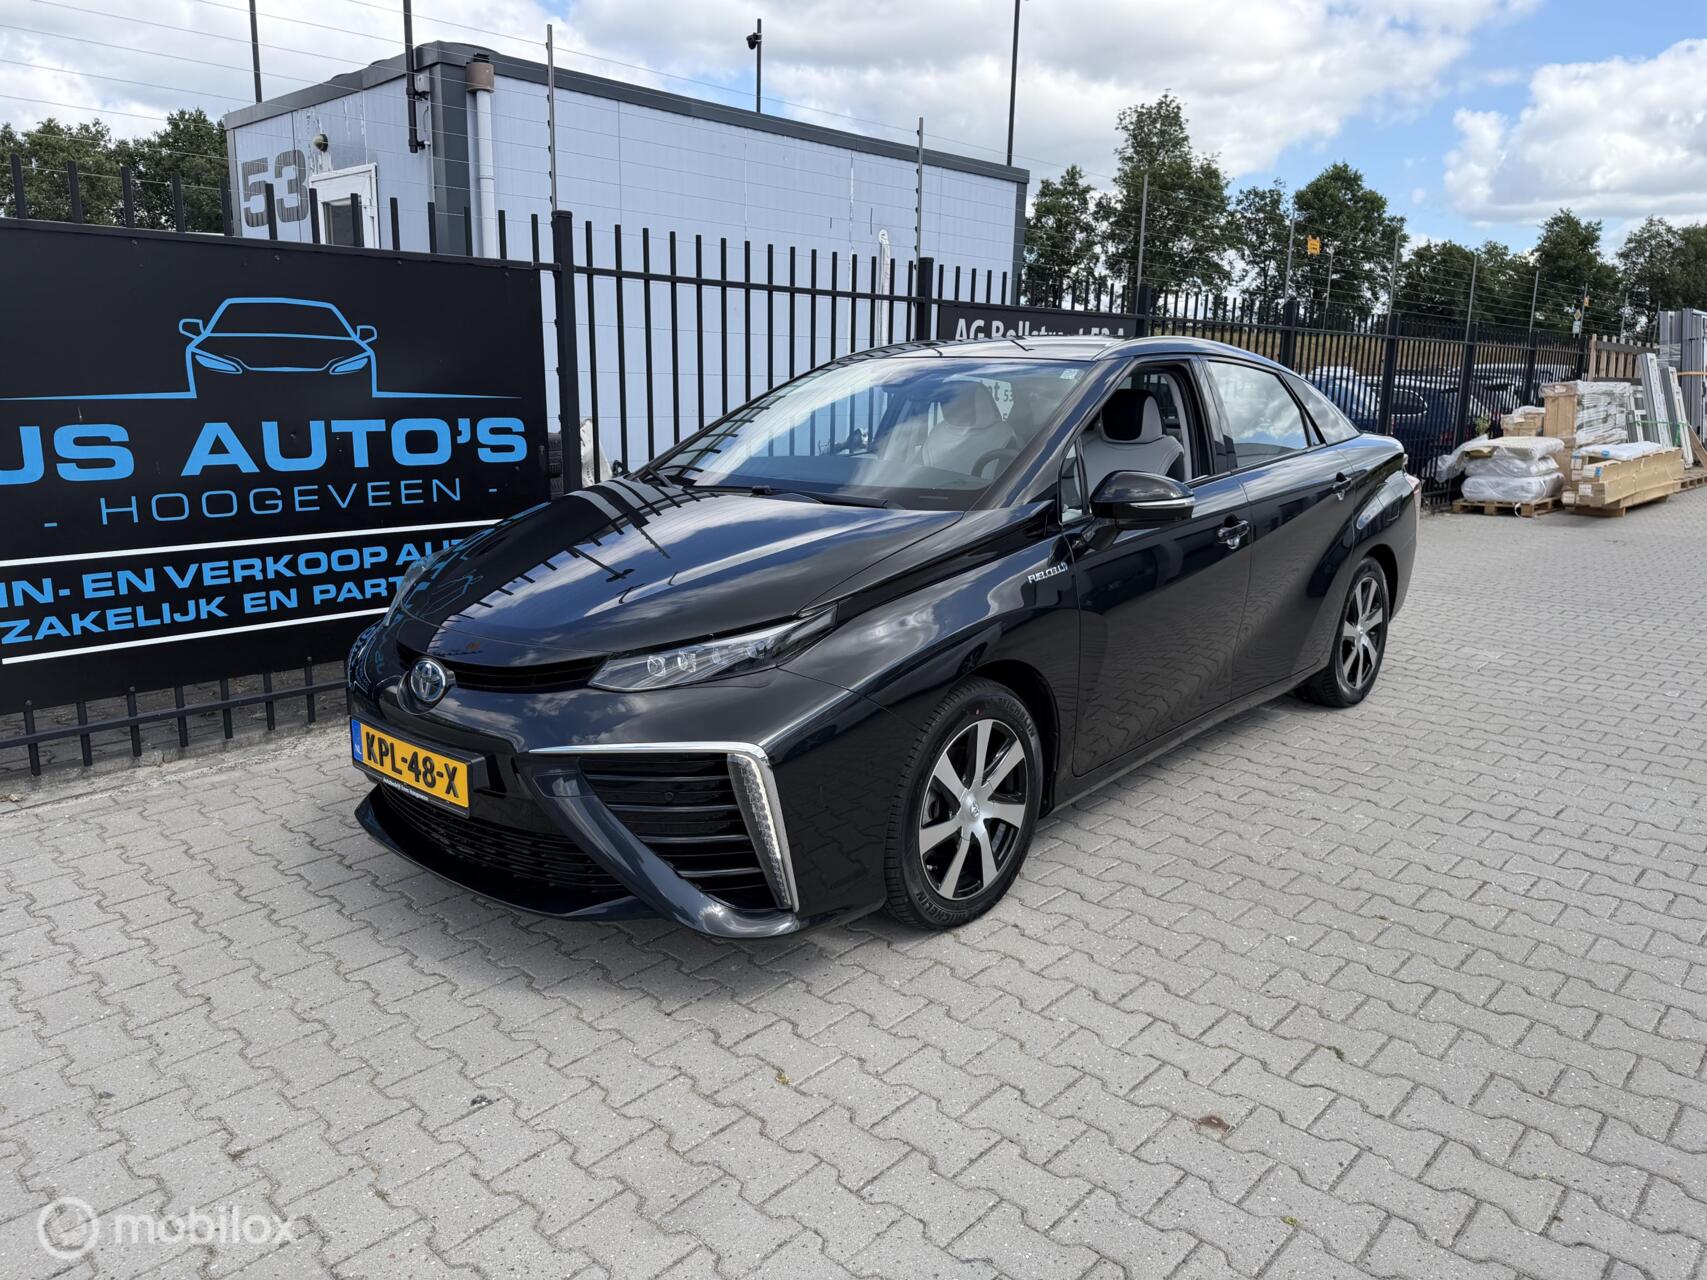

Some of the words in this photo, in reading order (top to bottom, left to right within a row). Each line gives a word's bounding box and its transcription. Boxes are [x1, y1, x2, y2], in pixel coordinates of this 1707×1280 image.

[241, 150, 309, 227] 53
[955, 318, 985, 341] AG
[181, 417, 527, 477] AUTO'S
[100, 479, 461, 526] HOOGEVEEN
[82, 567, 156, 599] EN
[164, 545, 388, 589] VERKOOP
[0, 597, 226, 645] ZAKELIJK
[243, 587, 298, 614] EN
[366, 731, 459, 799] KPL-48-X
